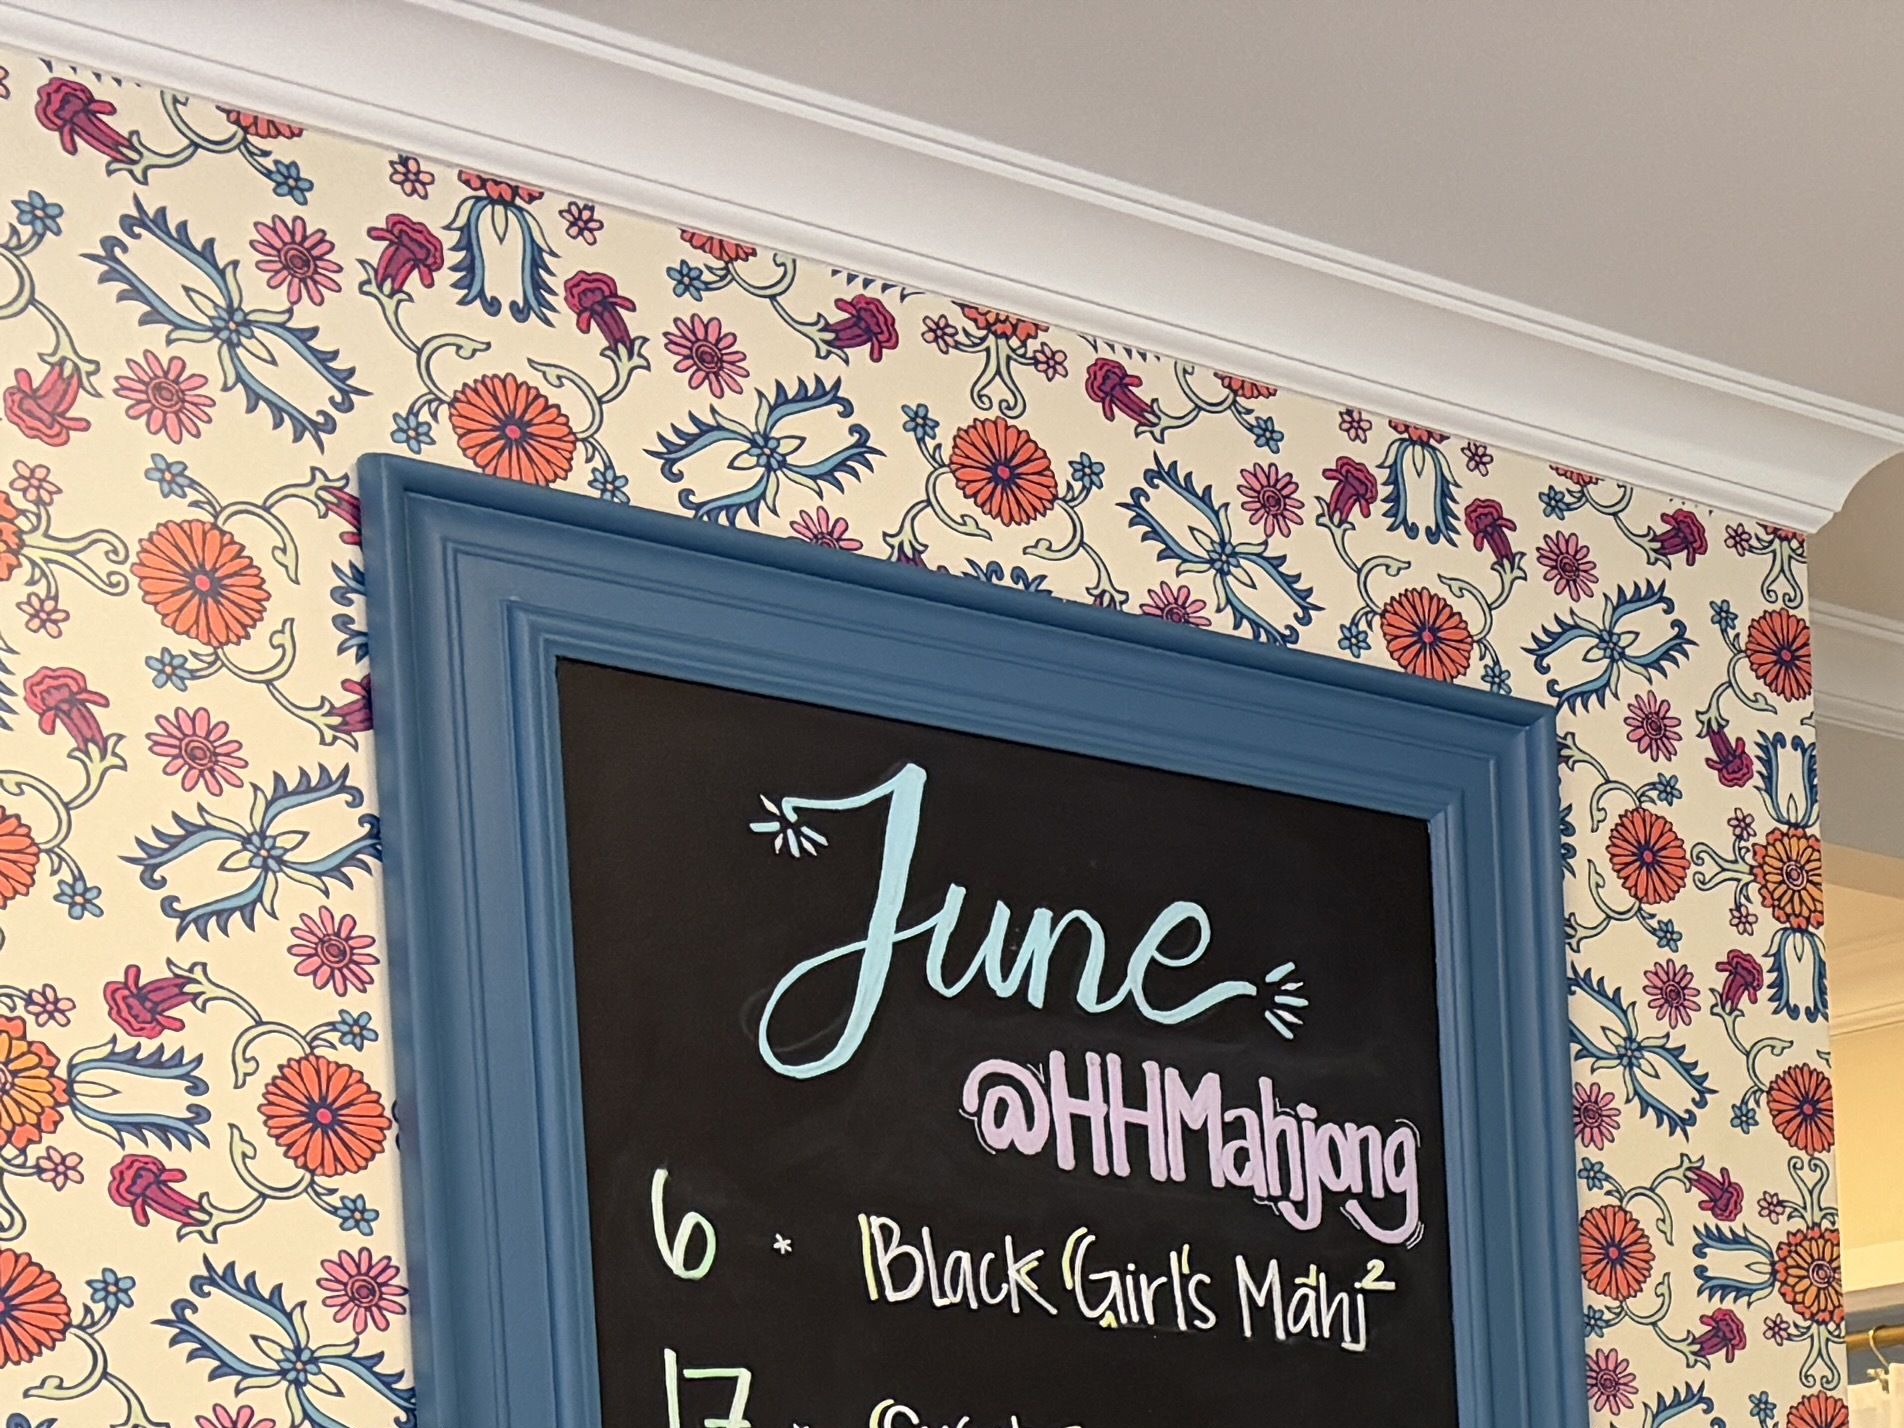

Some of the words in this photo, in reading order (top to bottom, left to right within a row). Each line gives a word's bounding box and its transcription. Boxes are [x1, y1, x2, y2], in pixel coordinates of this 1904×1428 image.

[758, 762, 1257, 1078] June
[651, 1168, 716, 1280] 6
[858, 1213, 1057, 1314] Black
[960, 1050, 1422, 1247] @HHMahjong
